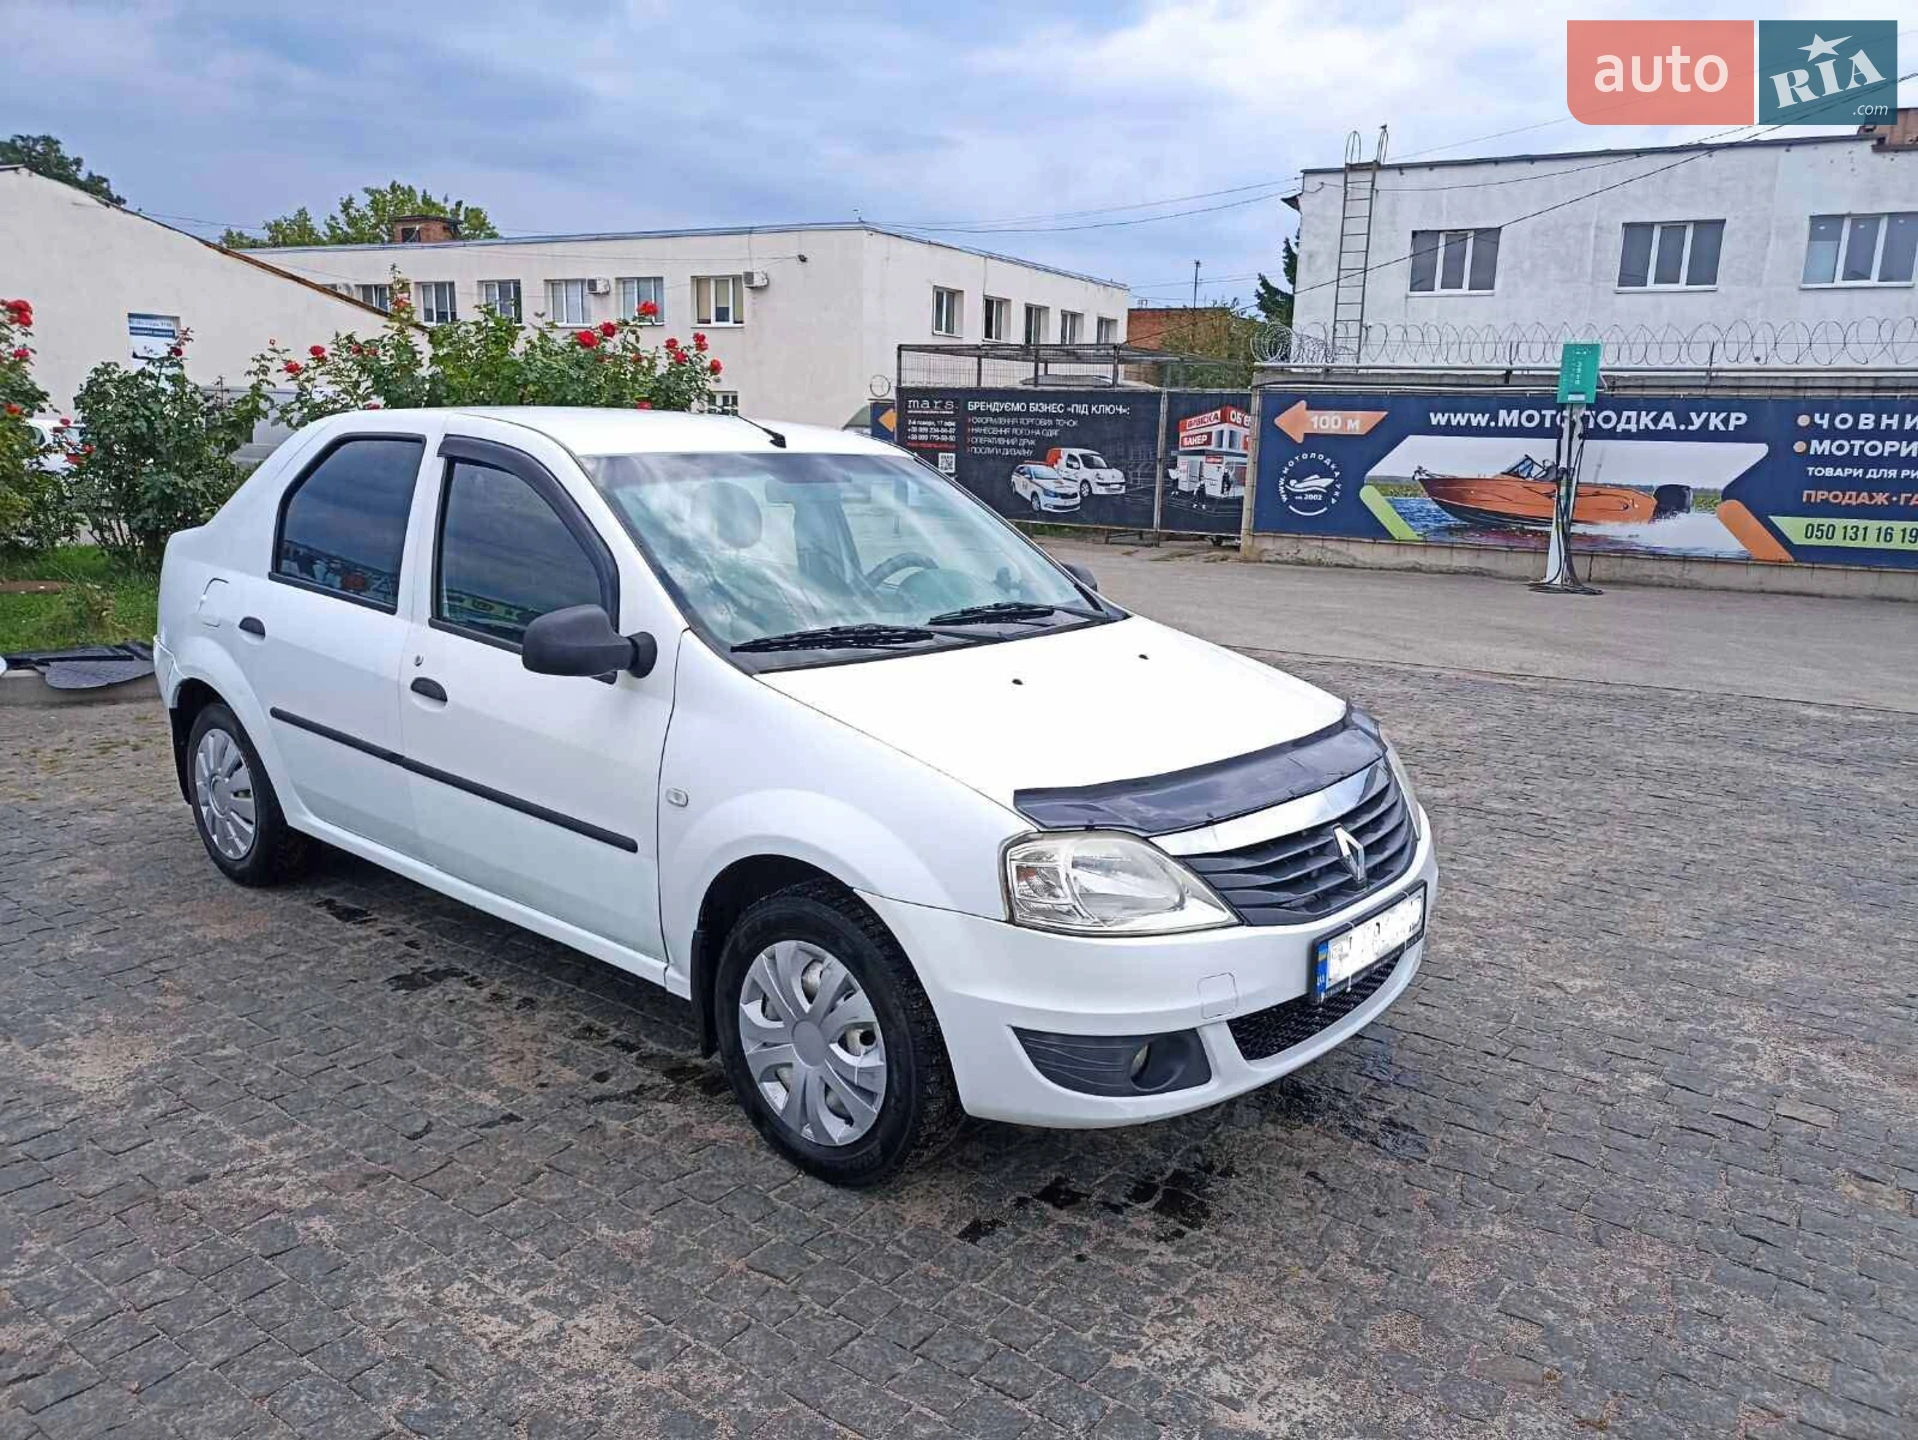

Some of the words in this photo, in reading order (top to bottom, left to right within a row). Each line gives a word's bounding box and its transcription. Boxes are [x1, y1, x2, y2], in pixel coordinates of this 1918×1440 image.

[967, 401, 1027, 413] БРЕНДУЄМО
[1029, 402, 1064, 413] БІЗНЕС
[1310, 414, 1342, 429] 100
[1814, 412, 1918, 430] ЧОВНИ
[1809, 439, 1918, 457] МОТОРИ
[1806, 466, 1863, 478] ТОВАРИ
[1865, 468, 1898, 479] ДЛЯ
[1303, 493, 1323, 501] 2002
[1802, 489, 1890, 506] ПРОДАЖ
[1804, 523, 1836, 540] 050
[1842, 524, 1869, 542] 131
[1875, 526, 1894, 543] 16
[1900, 527, 1918, 544] 19
